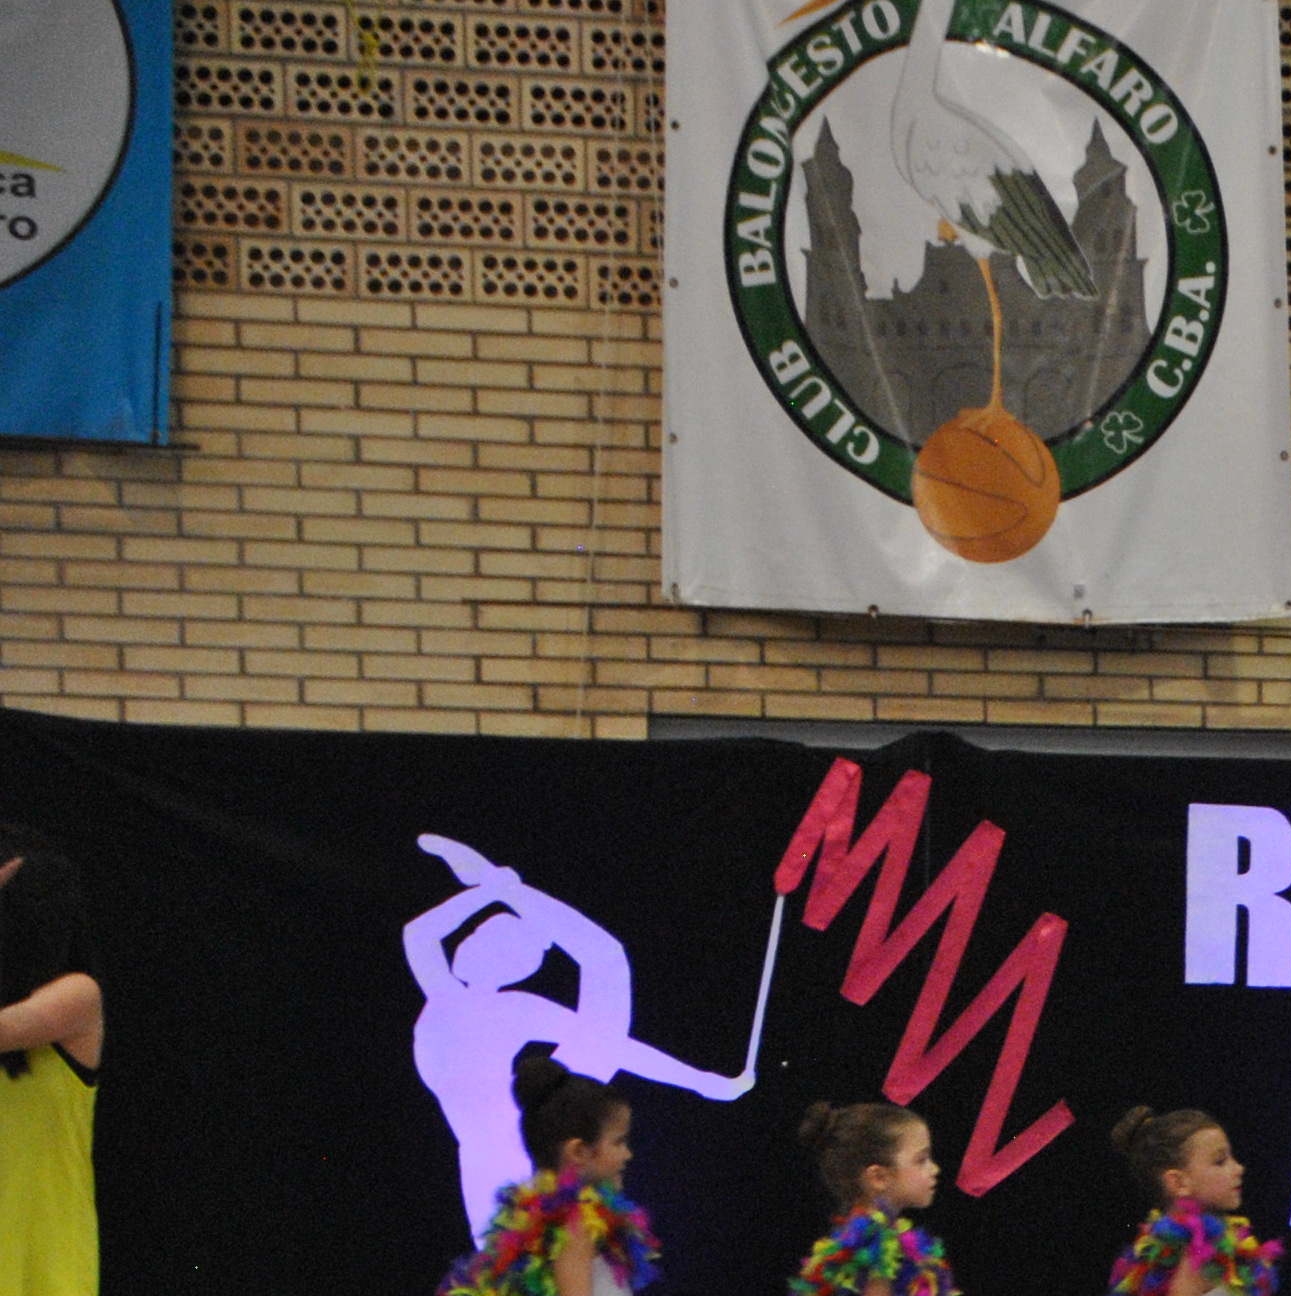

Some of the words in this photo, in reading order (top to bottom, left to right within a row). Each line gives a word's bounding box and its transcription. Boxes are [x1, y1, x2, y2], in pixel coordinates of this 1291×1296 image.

[769, 339, 880, 466] CLUB
[993, 2, 1179, 144] ALFARO
[1146, 261, 1216, 399] C.B.A.
